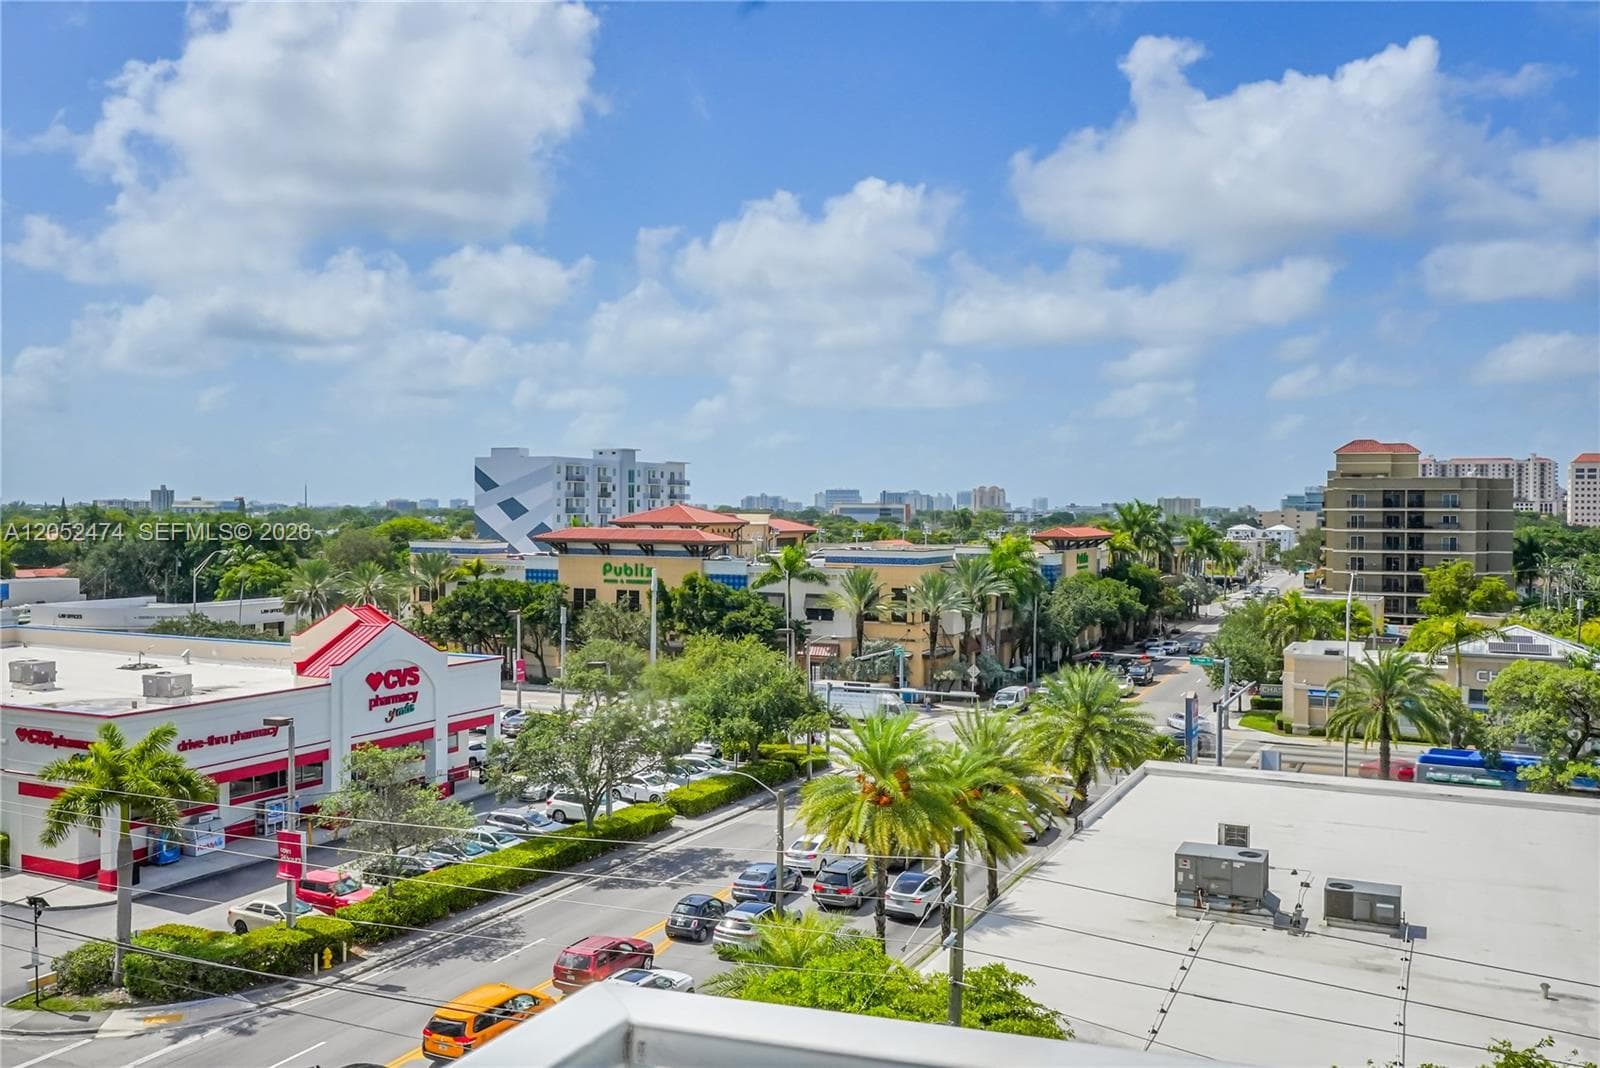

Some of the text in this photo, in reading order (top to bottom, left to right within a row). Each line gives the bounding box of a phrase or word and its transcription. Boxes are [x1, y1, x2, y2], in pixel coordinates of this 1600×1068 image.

[602, 562, 653, 577] Publix
[383, 666, 420, 690] CVS
[369, 691, 418, 711] pharmacy
[27, 729, 53, 746] CVS
[177, 726, 279, 752] drive-thru pharmacy
